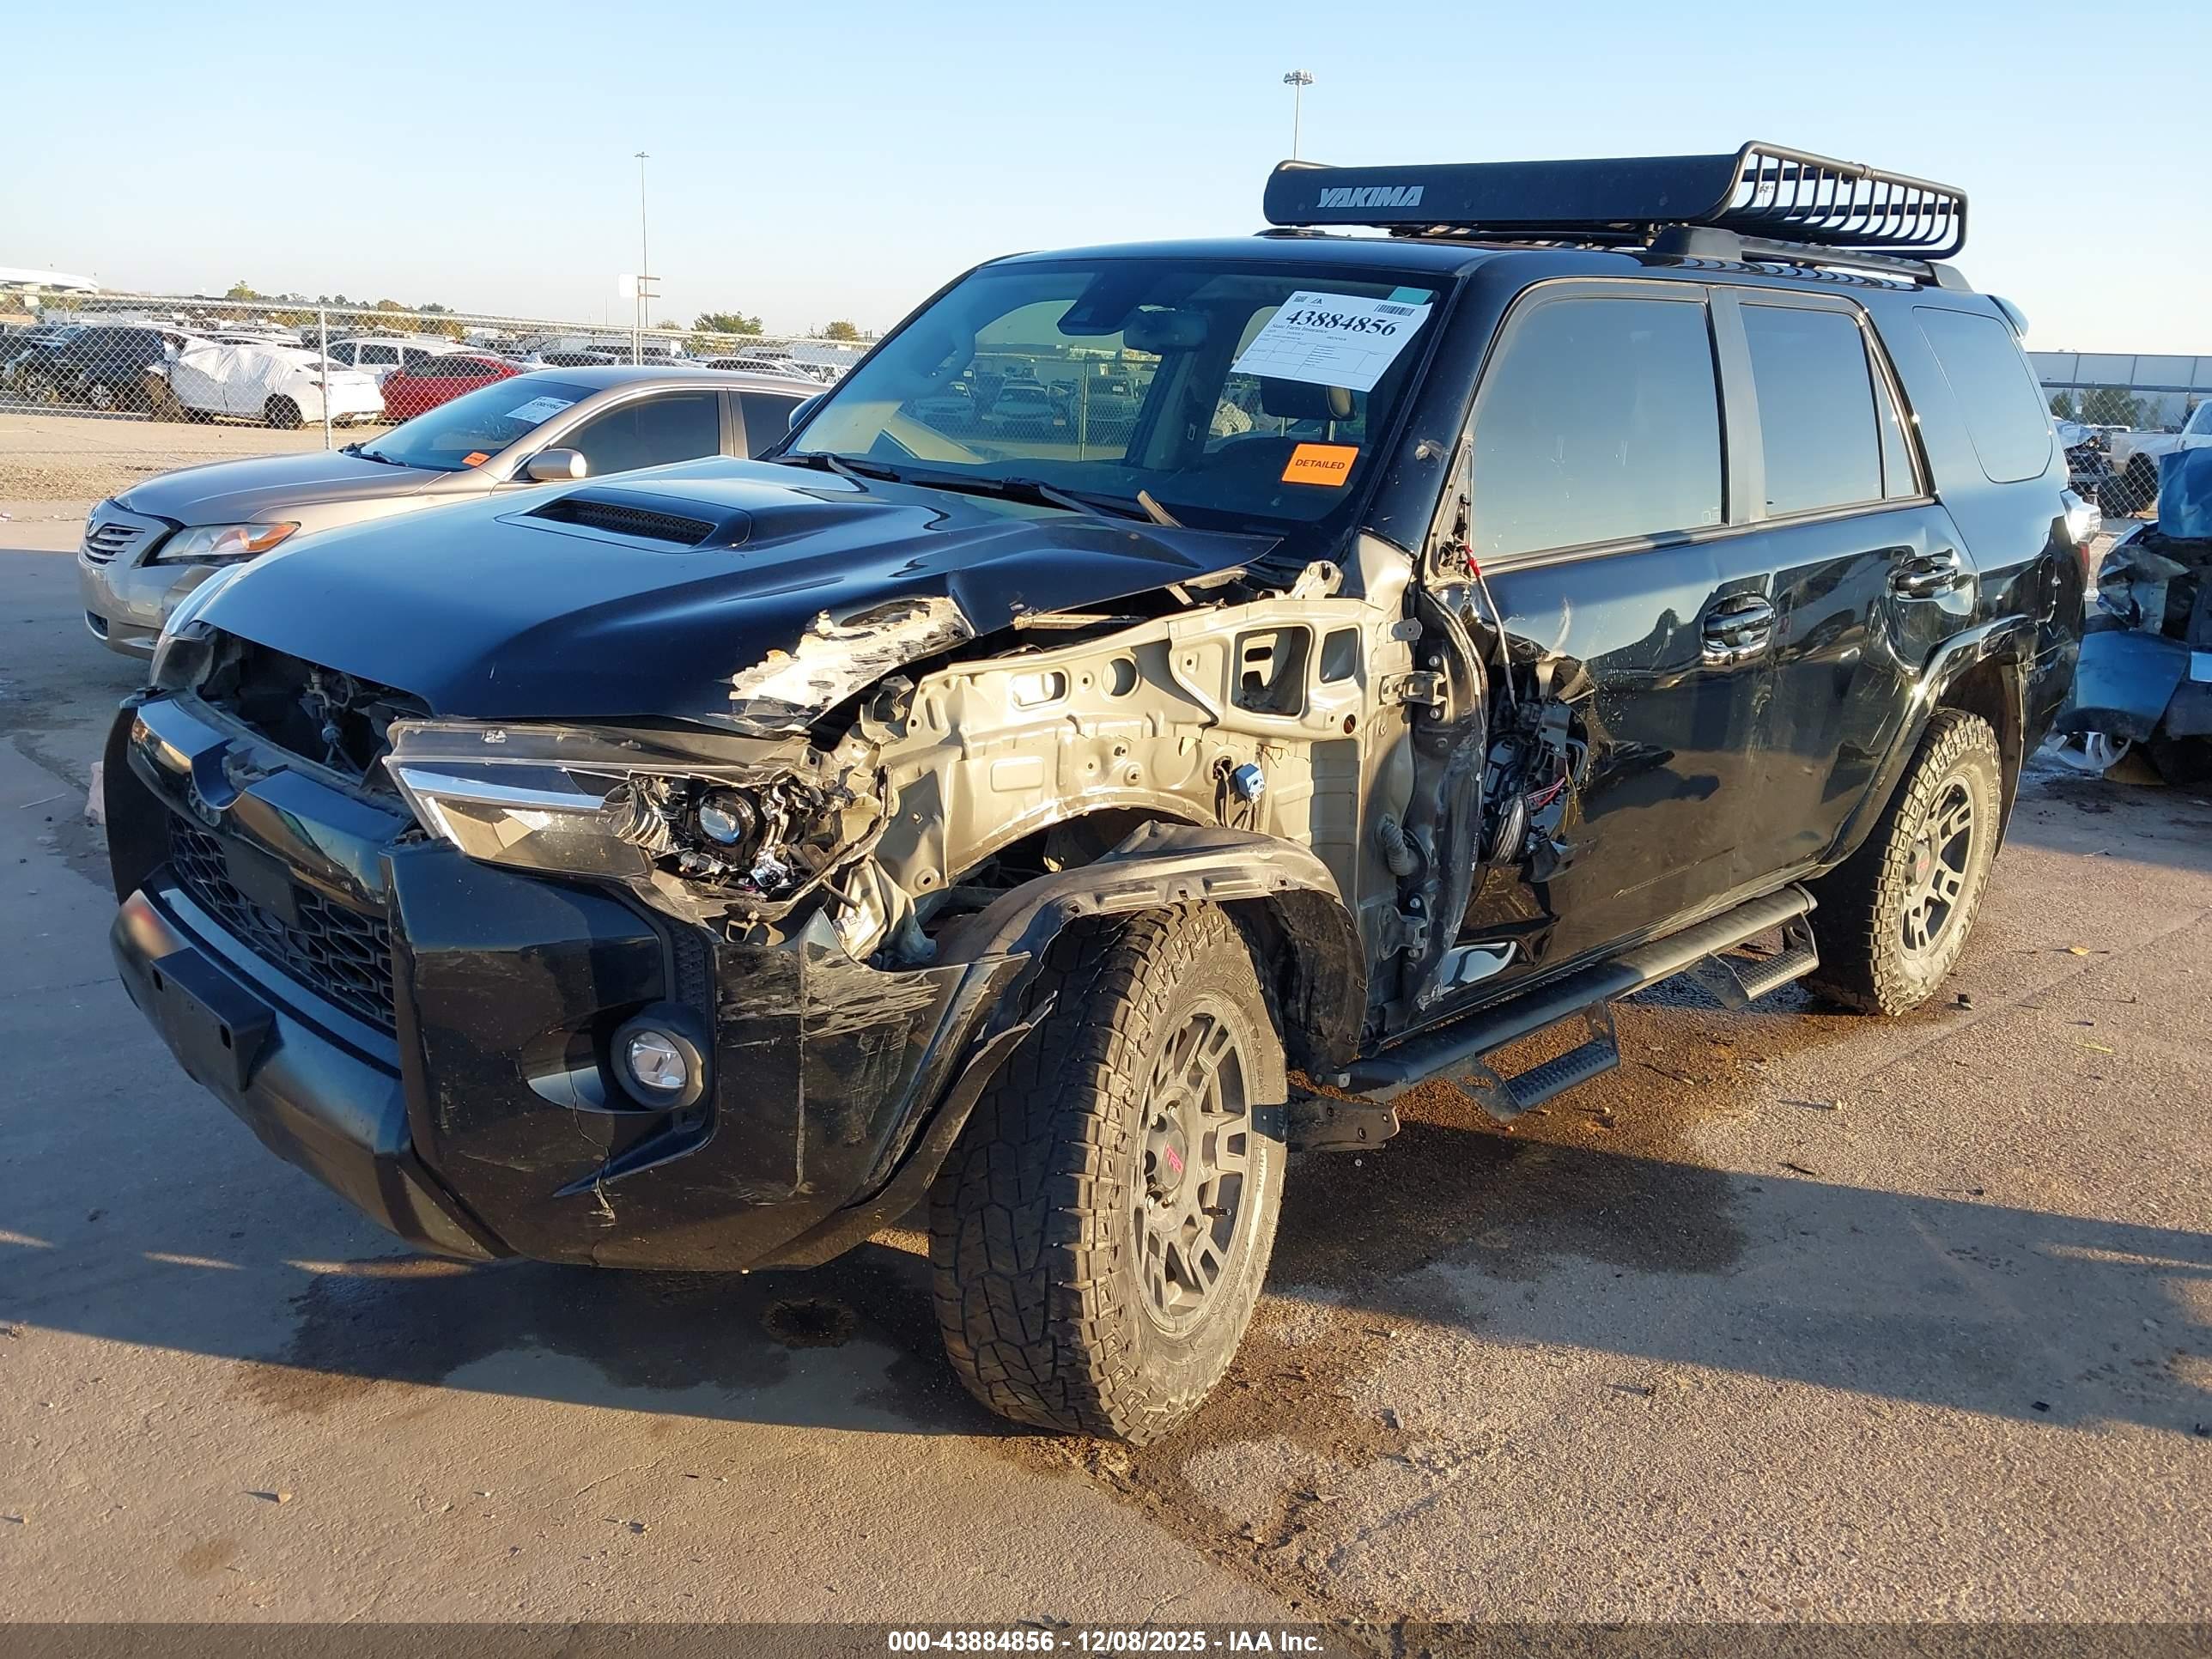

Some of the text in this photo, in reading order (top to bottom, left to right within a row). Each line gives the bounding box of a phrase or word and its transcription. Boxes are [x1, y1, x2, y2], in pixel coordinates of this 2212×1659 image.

[1316, 185, 1425, 207] YAKIMA
[1285, 309, 1402, 337] 43884856
[1295, 459, 1346, 470] DETAILED
